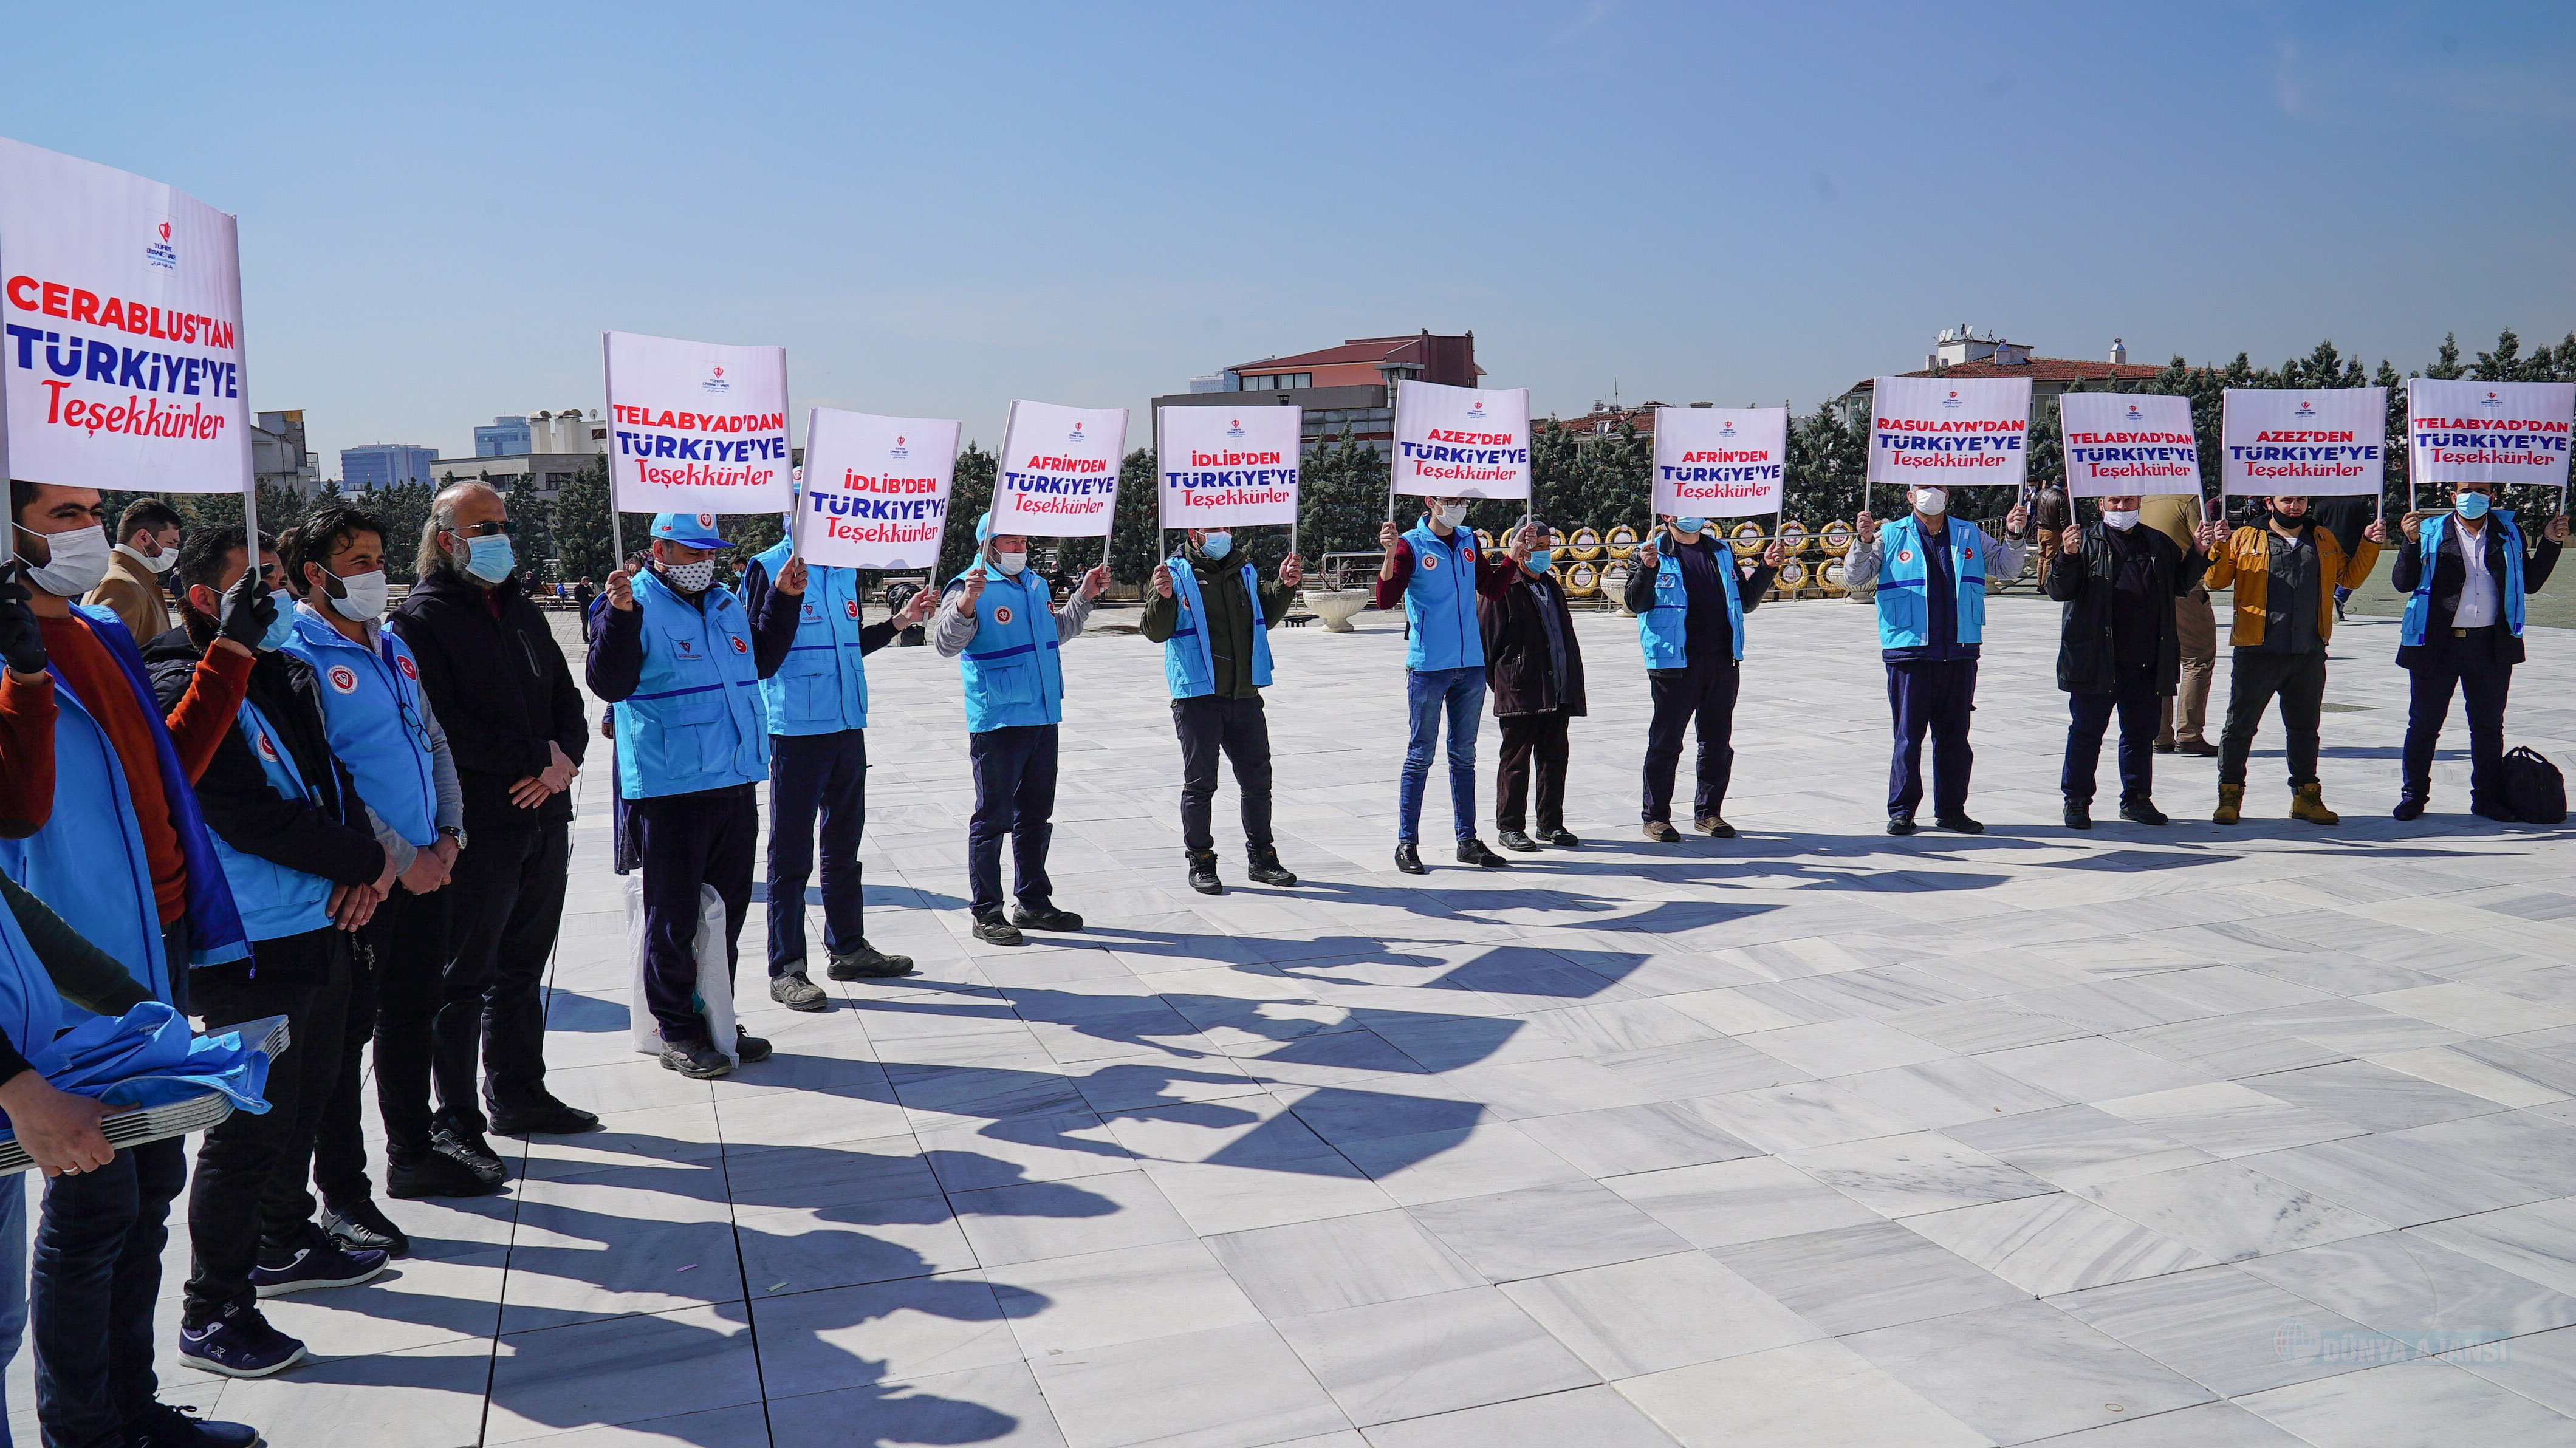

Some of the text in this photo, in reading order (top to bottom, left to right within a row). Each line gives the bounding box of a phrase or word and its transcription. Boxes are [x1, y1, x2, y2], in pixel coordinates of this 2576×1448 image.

[7, 276, 234, 350] CERABLUS'TAN
[41, 380, 224, 439] Teşekkürler
[613, 404, 784, 432] TELABYAD'DAN
[1877, 418, 2025, 432] RASULAYN'DAN
[2414, 417, 2569, 432] TELABYAD'DAN
[1428, 428, 1512, 446] AZEZ'DEN
[2069, 432, 2193, 445] TELABYAD'DAN
[2256, 431, 2354, 443] AZEZ'DEN
[1027, 453, 1106, 473] AFRİN'DEN
[1191, 449, 1281, 467] İDLİB'DEN
[1682, 447, 1769, 463] AFRİN'DEN
[1891, 450, 2006, 469] Teşekkürler
[2431, 448, 2555, 466] Teşekkürler
[634, 459, 773, 488] Teşekkürler
[1413, 459, 1516, 480] Teşekkürler
[2087, 462, 2191, 479] Teşekkürler
[2244, 461, 2364, 479] Teşekkürler
[844, 468, 937, 494] İDLİB'DEN
[1181, 487, 1289, 510] Teşekkürler
[1674, 482, 1771, 500] Teşekkürler
[1015, 493, 1104, 516] Teşekkürler
[825, 516, 939, 545] Teşekkürler
